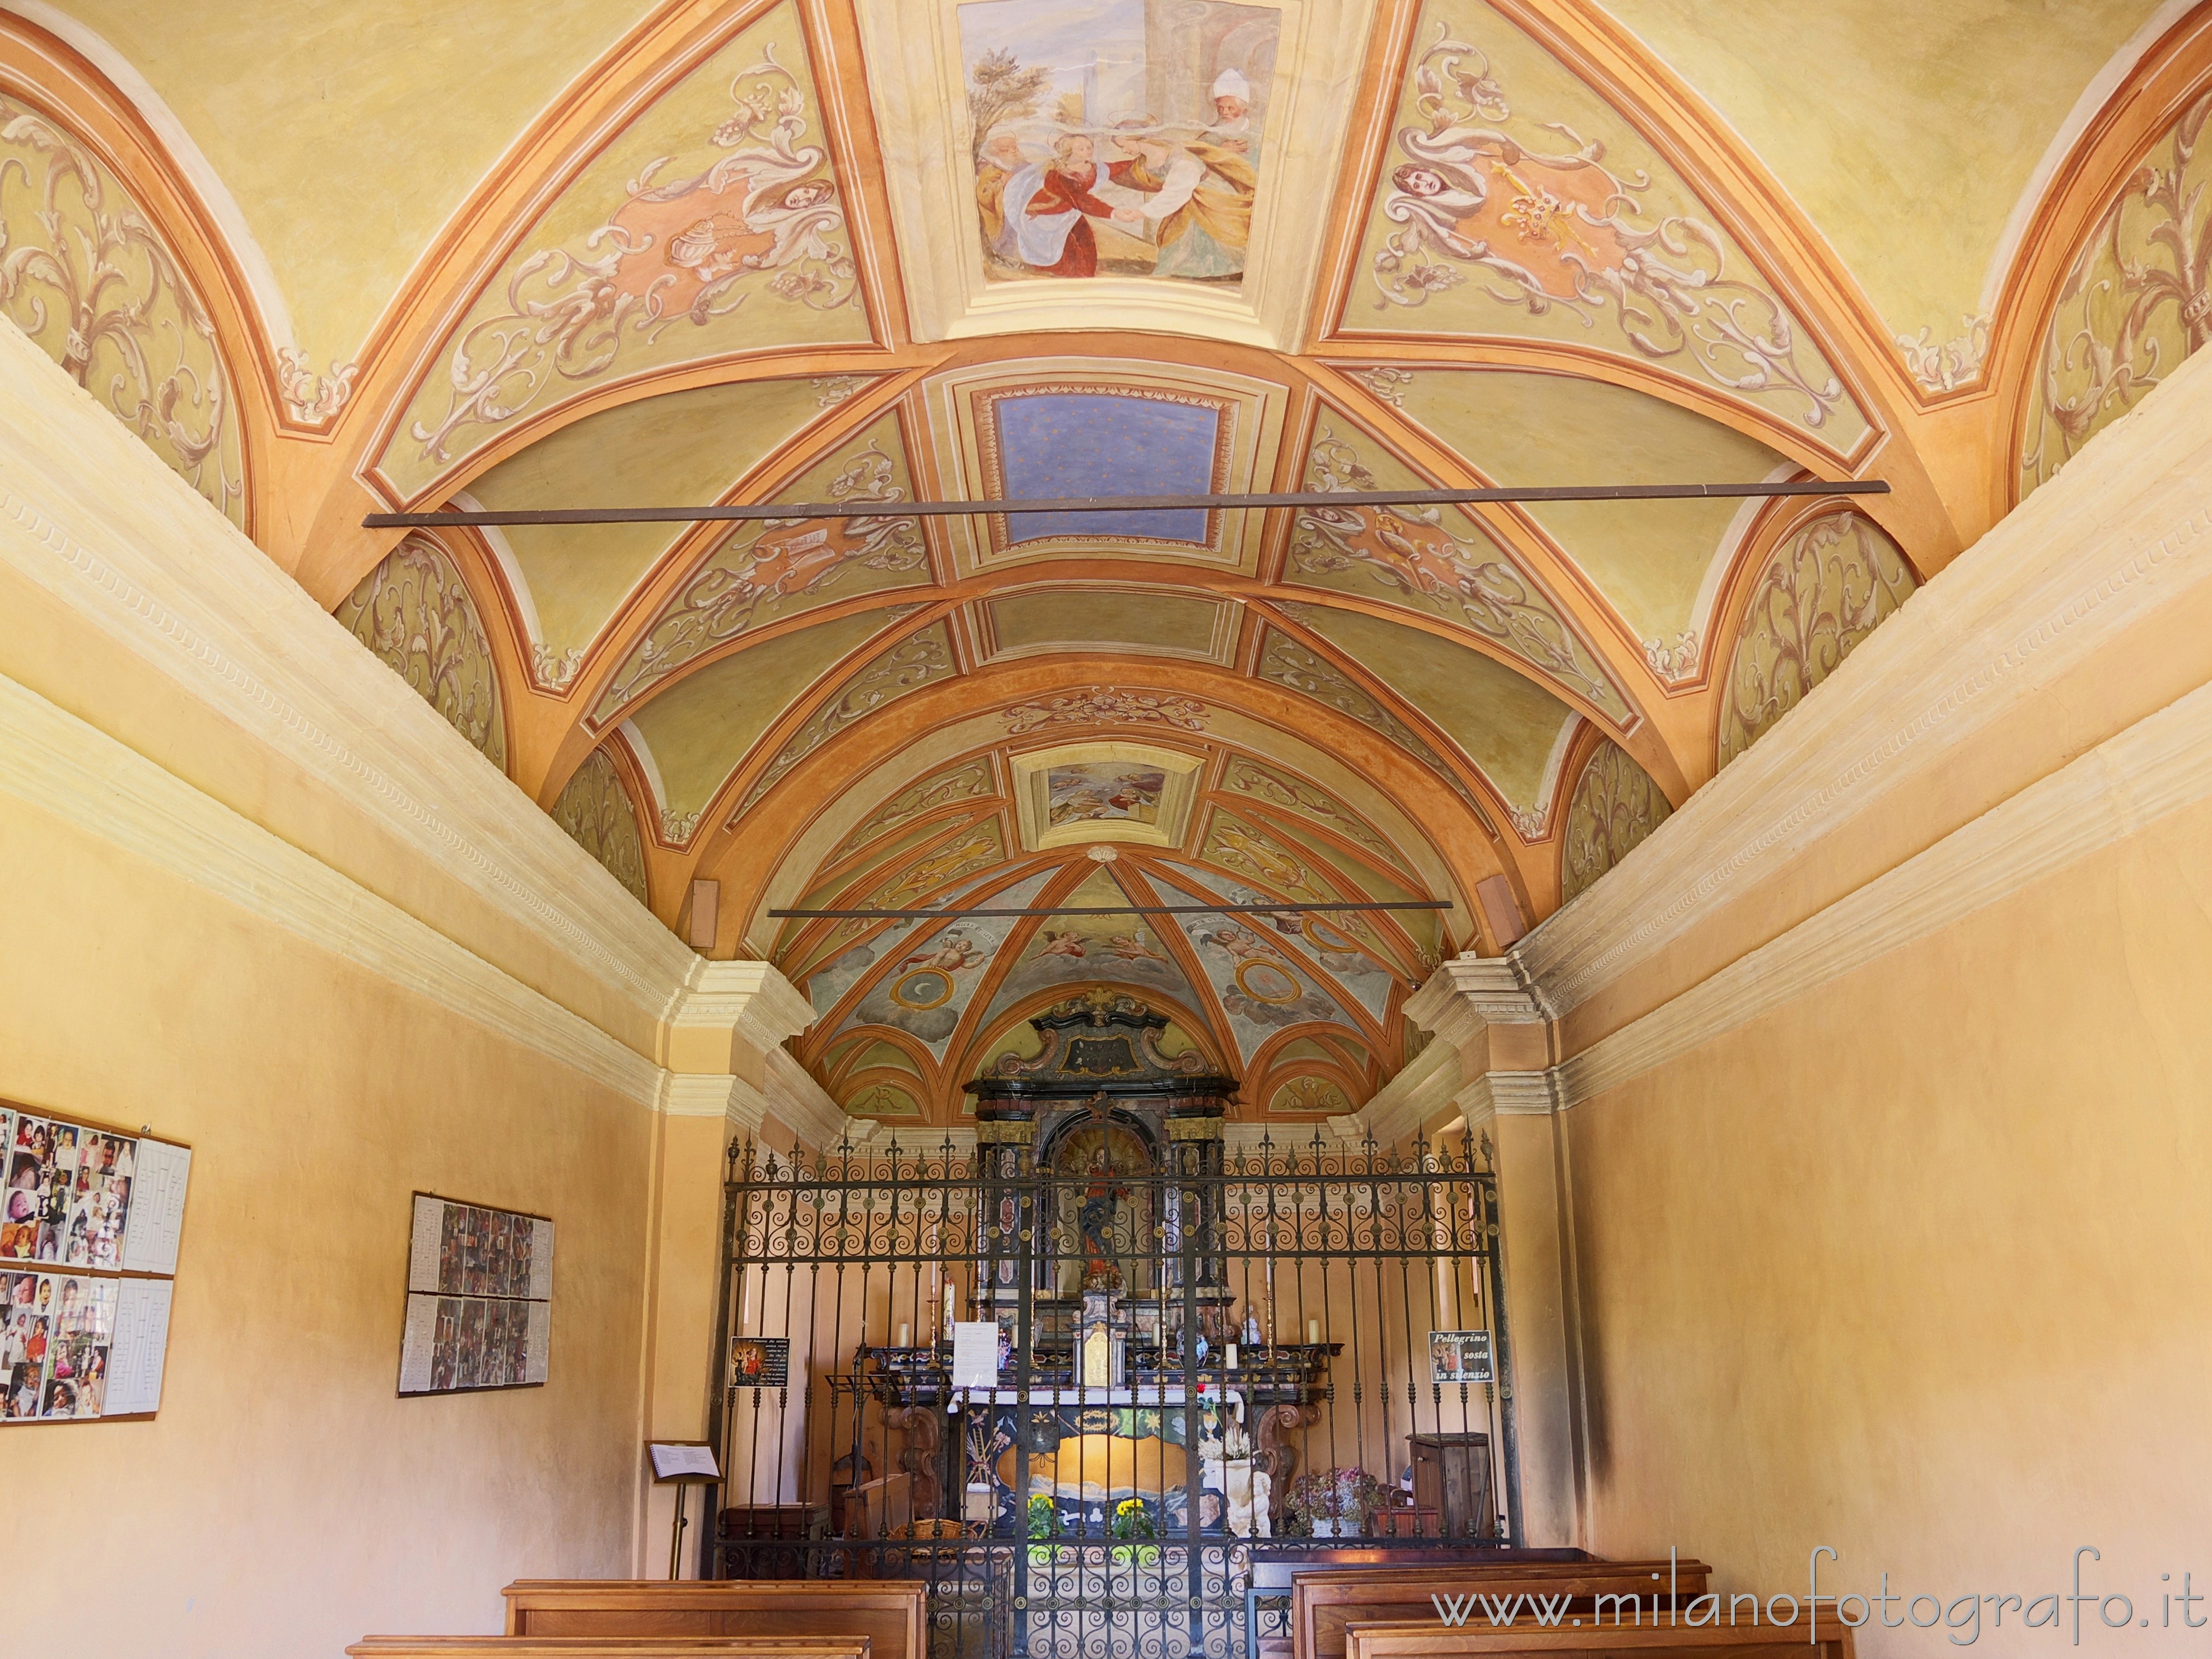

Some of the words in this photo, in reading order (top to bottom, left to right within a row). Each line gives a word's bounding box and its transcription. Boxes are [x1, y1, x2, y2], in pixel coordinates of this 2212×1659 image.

[1434, 1333, 1487, 1345] Pellegrino
[1463, 1350, 1488, 1359] sosta
[1436, 1369, 1448, 1380] in
[1450, 1368, 1490, 1380] silenzio
